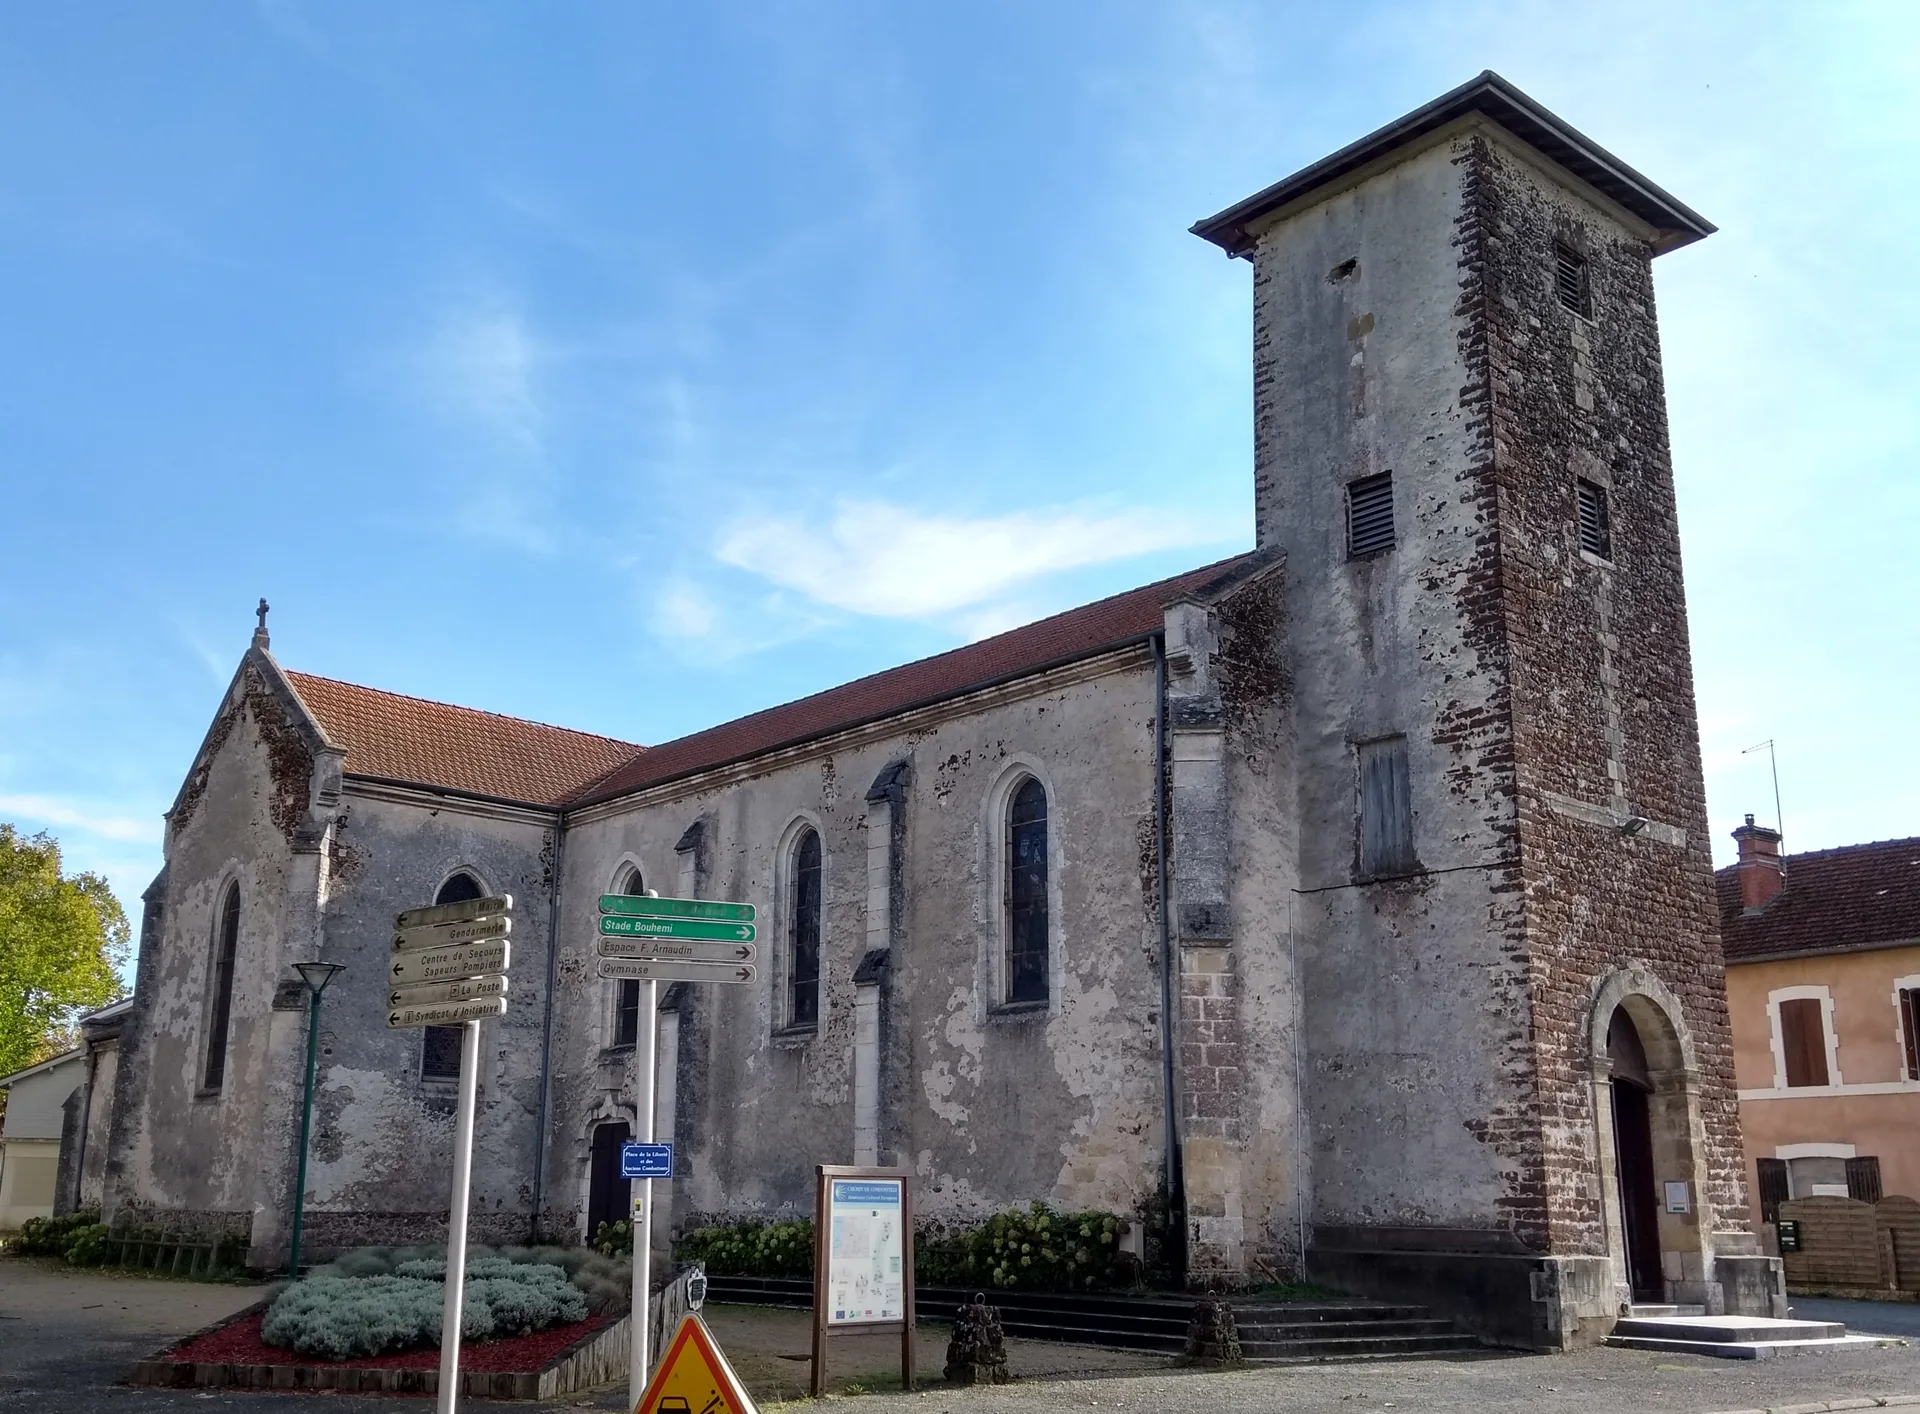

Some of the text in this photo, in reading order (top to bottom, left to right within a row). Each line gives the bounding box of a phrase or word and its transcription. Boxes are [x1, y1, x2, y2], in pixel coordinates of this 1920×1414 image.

[450, 922, 504, 939] Gendarmerie
[605, 920, 673, 933] Stade Bouhemi
[604, 941, 693, 955] Espace F. Arnaudin
[421, 947, 502, 965] Centre de Secours
[424, 959, 502, 978] Sapeurs Pompiers
[604, 963, 649, 974] Gymnase
[461, 982, 500, 995] La Poste
[415, 1010, 449, 1022] Syndicat
[453, 1003, 499, 1017] d'Initiative
